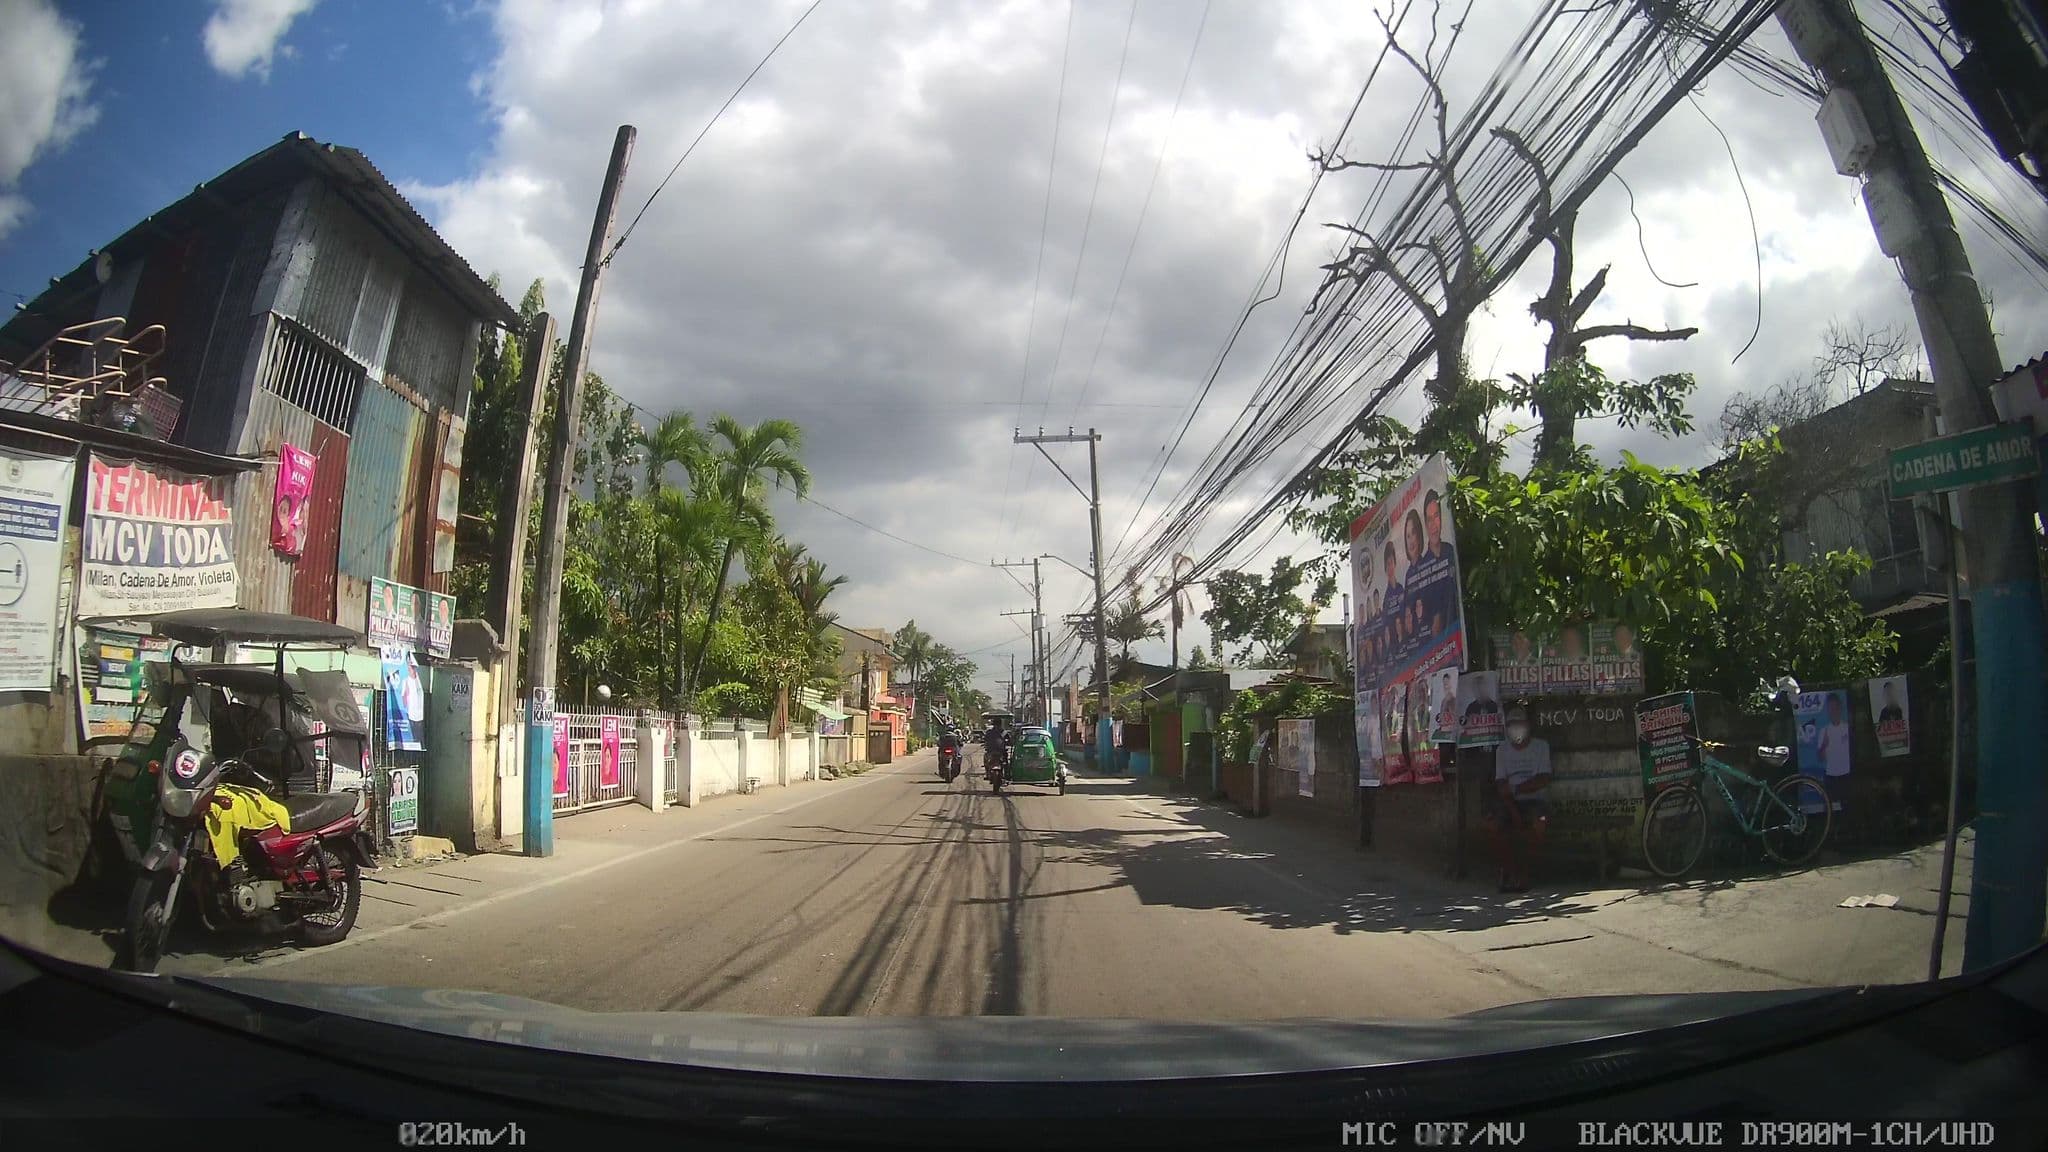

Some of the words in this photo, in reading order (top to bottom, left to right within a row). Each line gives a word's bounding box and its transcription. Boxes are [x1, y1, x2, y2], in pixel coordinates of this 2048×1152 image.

[1893, 452, 1957, 483] CADENA
[1961, 445, 1983, 470] DE
[1987, 436, 2033, 465] AMOR
[292, 470, 307, 487] KIK
[93, 461, 229, 520] TERMINAL
[89, 518, 153, 564] MCV
[161, 526, 229, 564] TODA
[119, 571, 156, 588] Cadena
[157, 572, 170, 588] De
[198, 569, 235, 586] Violeta)
[431, 627, 450, 645] ILLAS
[1500, 665, 1538, 684] ILLAS
[1543, 663, 1590, 682] PILLAS
[1594, 661, 1641, 680] PILLAS
[1799, 694, 1821, 709] 164
[1539, 710, 1577, 727] MCV
[1586, 707, 1624, 722] TODA
[1639, 713, 1690, 732] PRINTING
